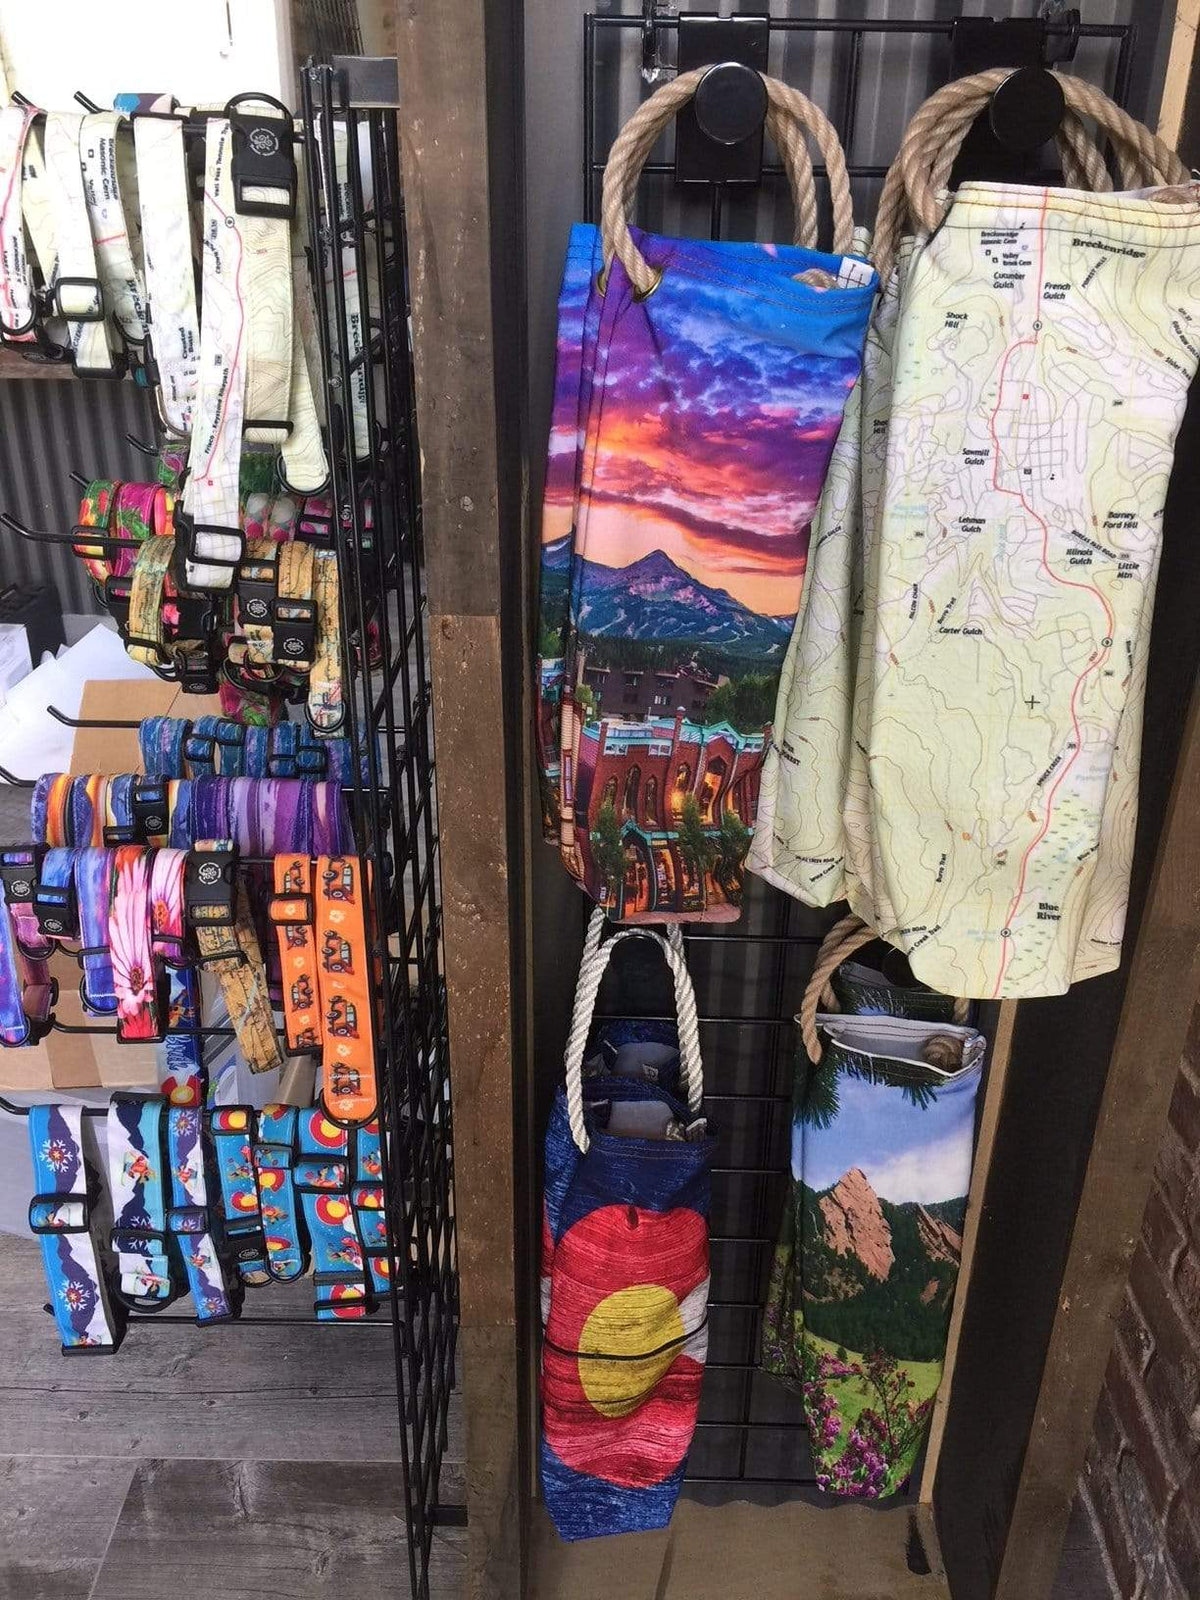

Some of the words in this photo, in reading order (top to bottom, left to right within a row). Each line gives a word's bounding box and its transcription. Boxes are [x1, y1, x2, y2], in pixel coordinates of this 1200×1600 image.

[98, 138, 109, 176] Masonic
[1072, 238, 1146, 258] Breckenridge
[993, 272, 1026, 280] Cucumber
[1044, 282, 1071, 290] French
[1043, 292, 1066, 300] Gulch
[946, 312, 968, 320] Shock
[944, 320, 960, 328] Hill
[964, 458, 985, 466] Gulch
[1108, 511, 1136, 520] Barney
[1118, 562, 1140, 570] Little
[938, 627, 961, 635] Carter
[962, 627, 983, 636] Gulch
[1038, 902, 1060, 912] Blue
[1036, 912, 1062, 921] River
[928, 924, 942, 936] Trail
